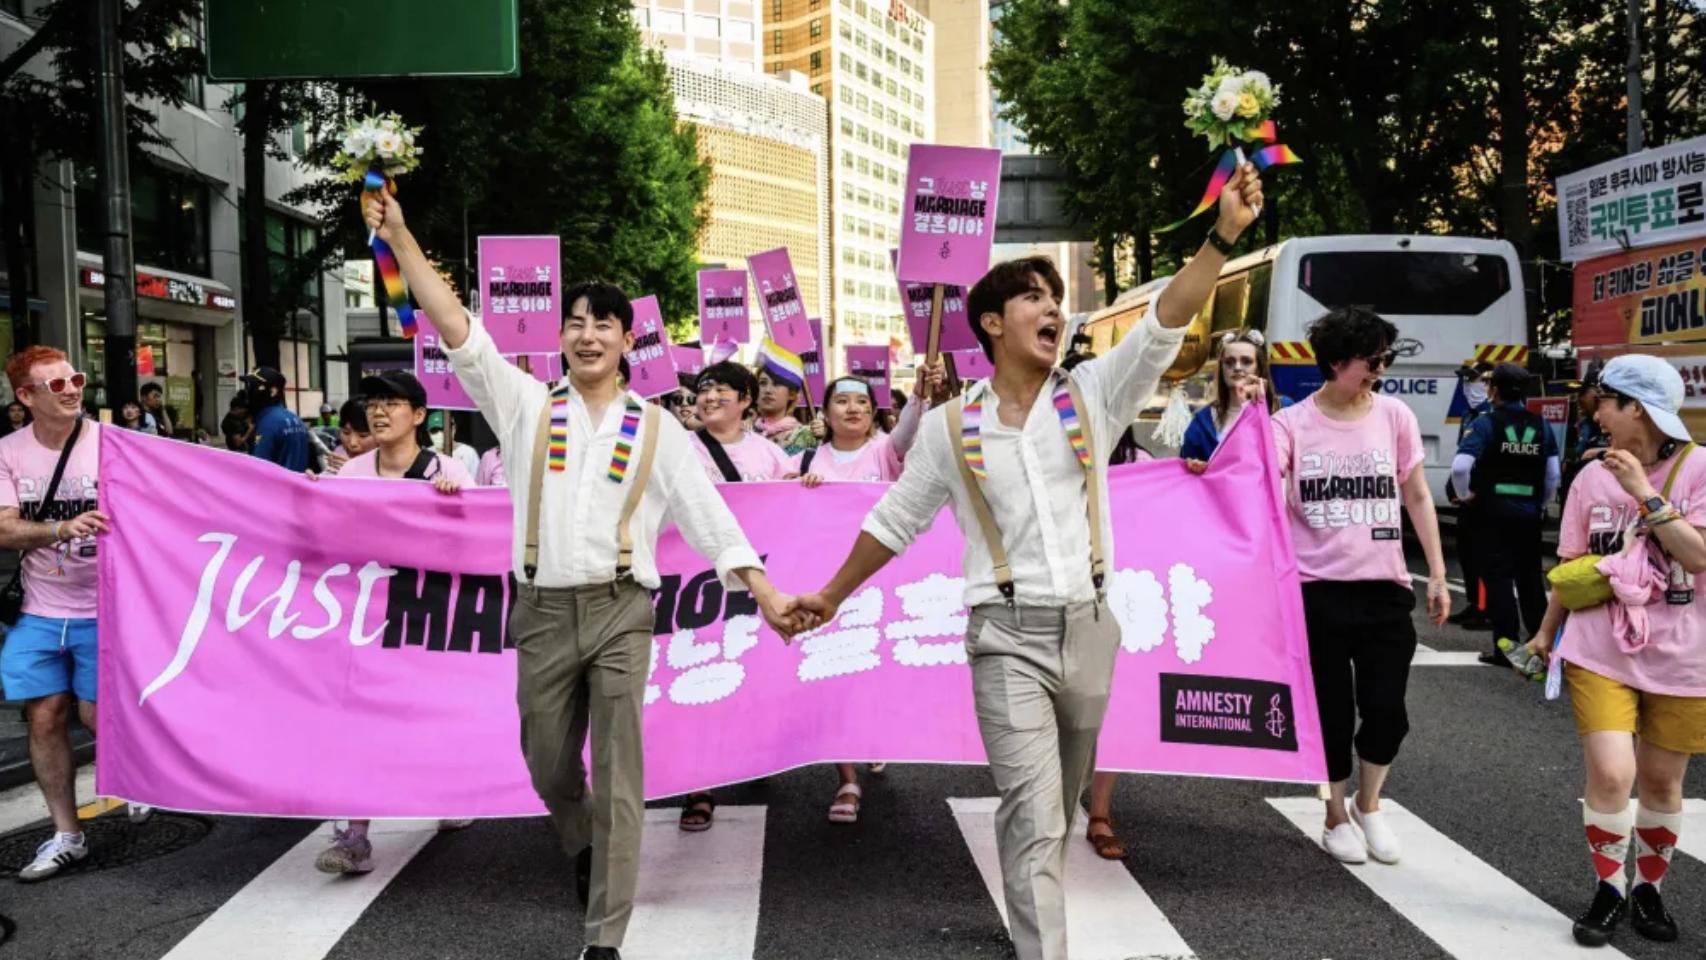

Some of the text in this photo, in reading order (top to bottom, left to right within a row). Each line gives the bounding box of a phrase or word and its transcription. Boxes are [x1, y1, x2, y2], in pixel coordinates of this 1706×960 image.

[1589, 175, 1608, 199] 일본
[1610, 162, 1659, 191] 후쿠시마
[1662, 152, 1705, 180] 방사능
[914, 195, 986, 217] MARRIAGE
[1590, 181, 1705, 240] 국민투표로
[914, 213, 984, 236] 결혼이야
[1608, 261, 1652, 297] 퀴어한
[1657, 250, 1694, 286] 삶을
[489, 281, 552, 297] MARRIAGE
[490, 297, 552, 314] 결혼이야
[1502, 442, 1541, 456] POLICE
[1299, 475, 1396, 503] MARRIAGE
[139, 531, 400, 707] Just
[1175, 688, 1253, 715] AMNESTY
[1175, 713, 1253, 732] INTERNATIONAL
